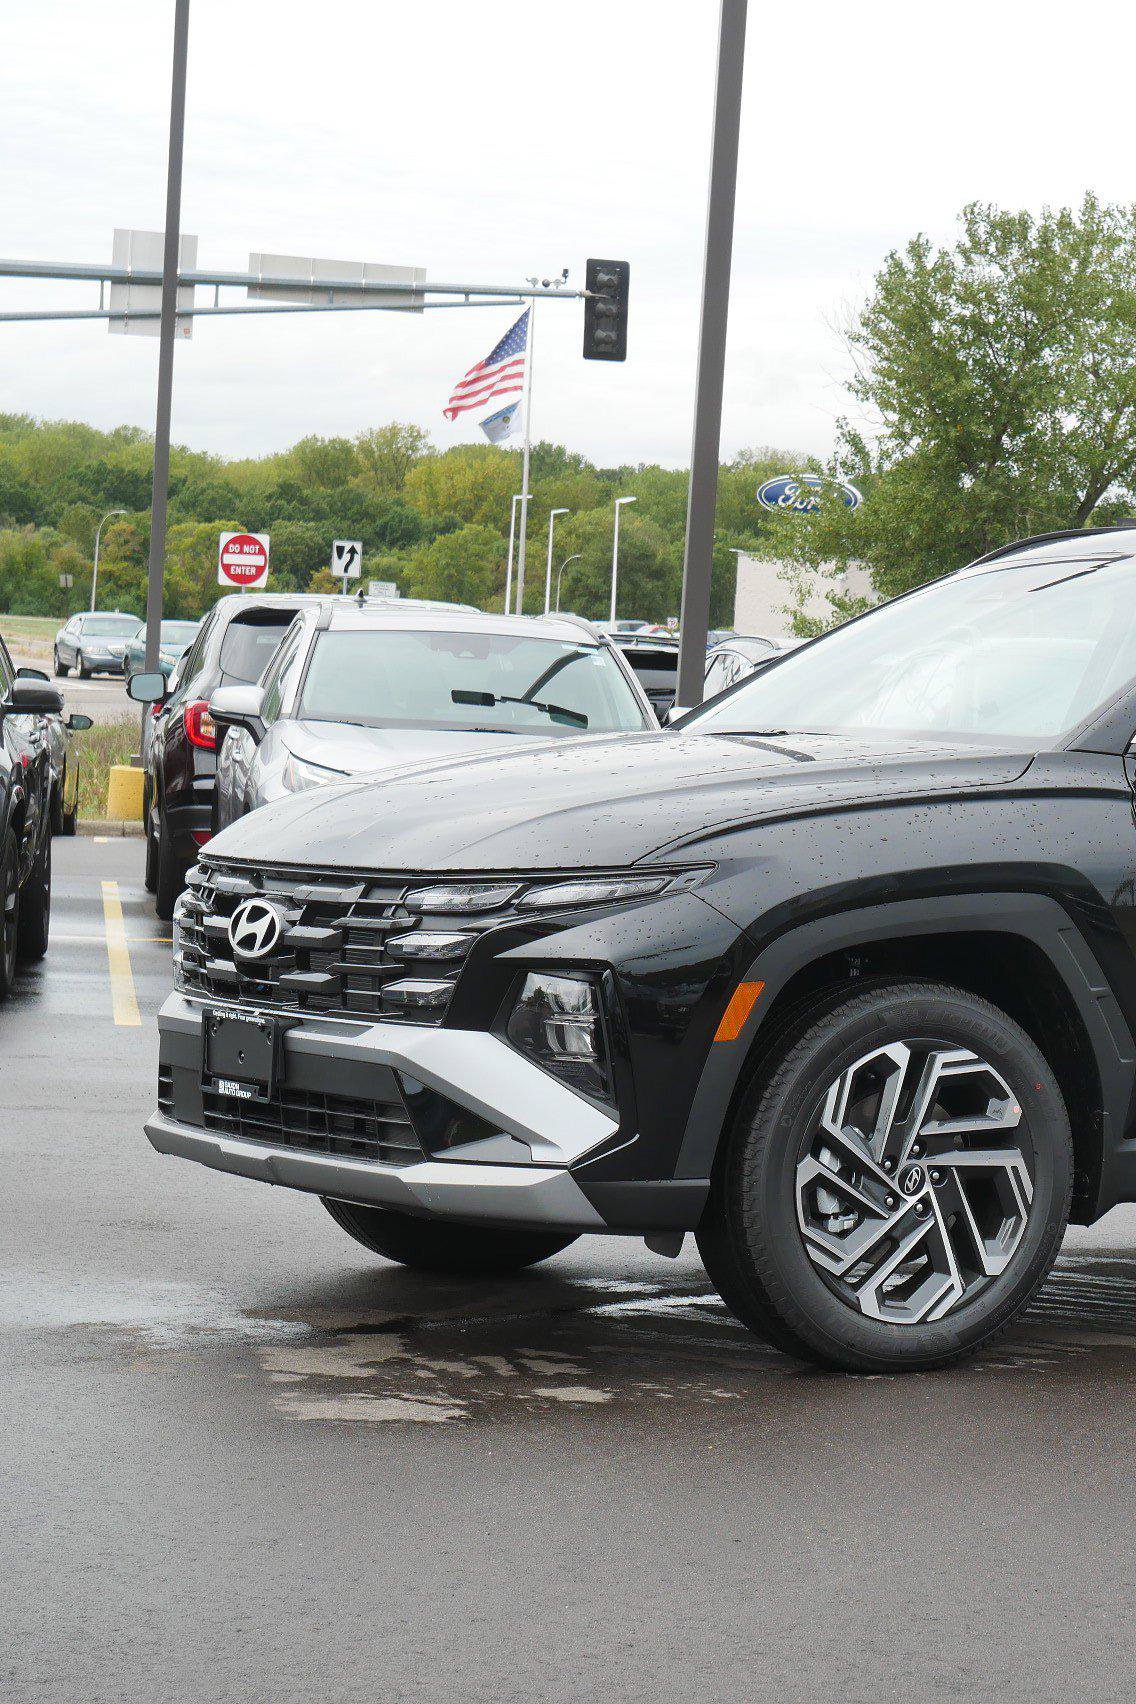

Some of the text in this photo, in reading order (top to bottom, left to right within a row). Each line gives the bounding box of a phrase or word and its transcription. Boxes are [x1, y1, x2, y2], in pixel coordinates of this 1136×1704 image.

[228, 543, 260, 554] DO NOT
[230, 565, 256, 576] ENTER
